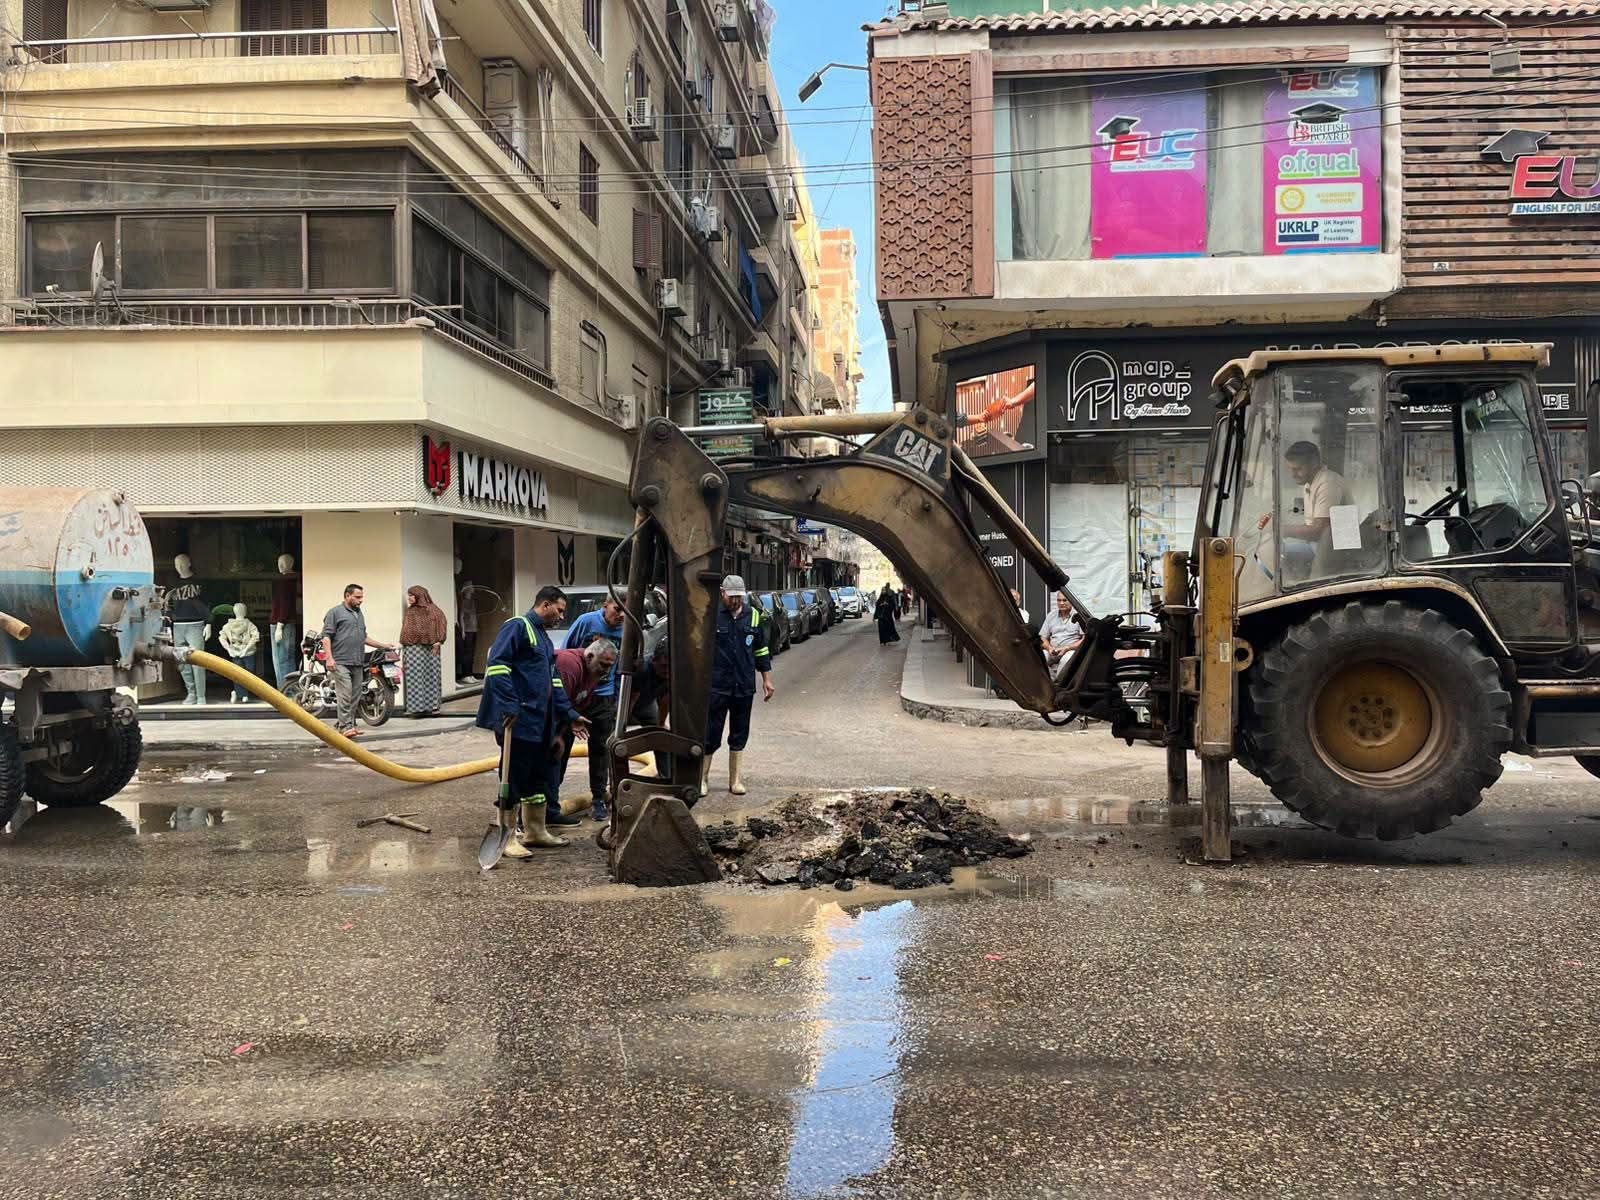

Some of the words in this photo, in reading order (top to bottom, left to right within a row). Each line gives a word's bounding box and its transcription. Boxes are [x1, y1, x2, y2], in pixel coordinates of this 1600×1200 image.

[1288, 68, 1360, 91] EUC
[1311, 123, 1348, 133] BRITISH
[1311, 133, 1349, 141] BOARD
[1112, 129, 1197, 162] EUC
[1280, 149, 1358, 176] ofqual
[1516, 204, 1558, 213] ENGLISH
[1560, 203, 1581, 212] FOR
[1279, 220, 1319, 233] UKRLP
[704, 391, 746, 412] كنوز
[1124, 382, 1191, 402] group
[895, 430, 942, 472] CAT
[459, 451, 550, 510] MARKOVA
[989, 556, 1014, 567] GNED
